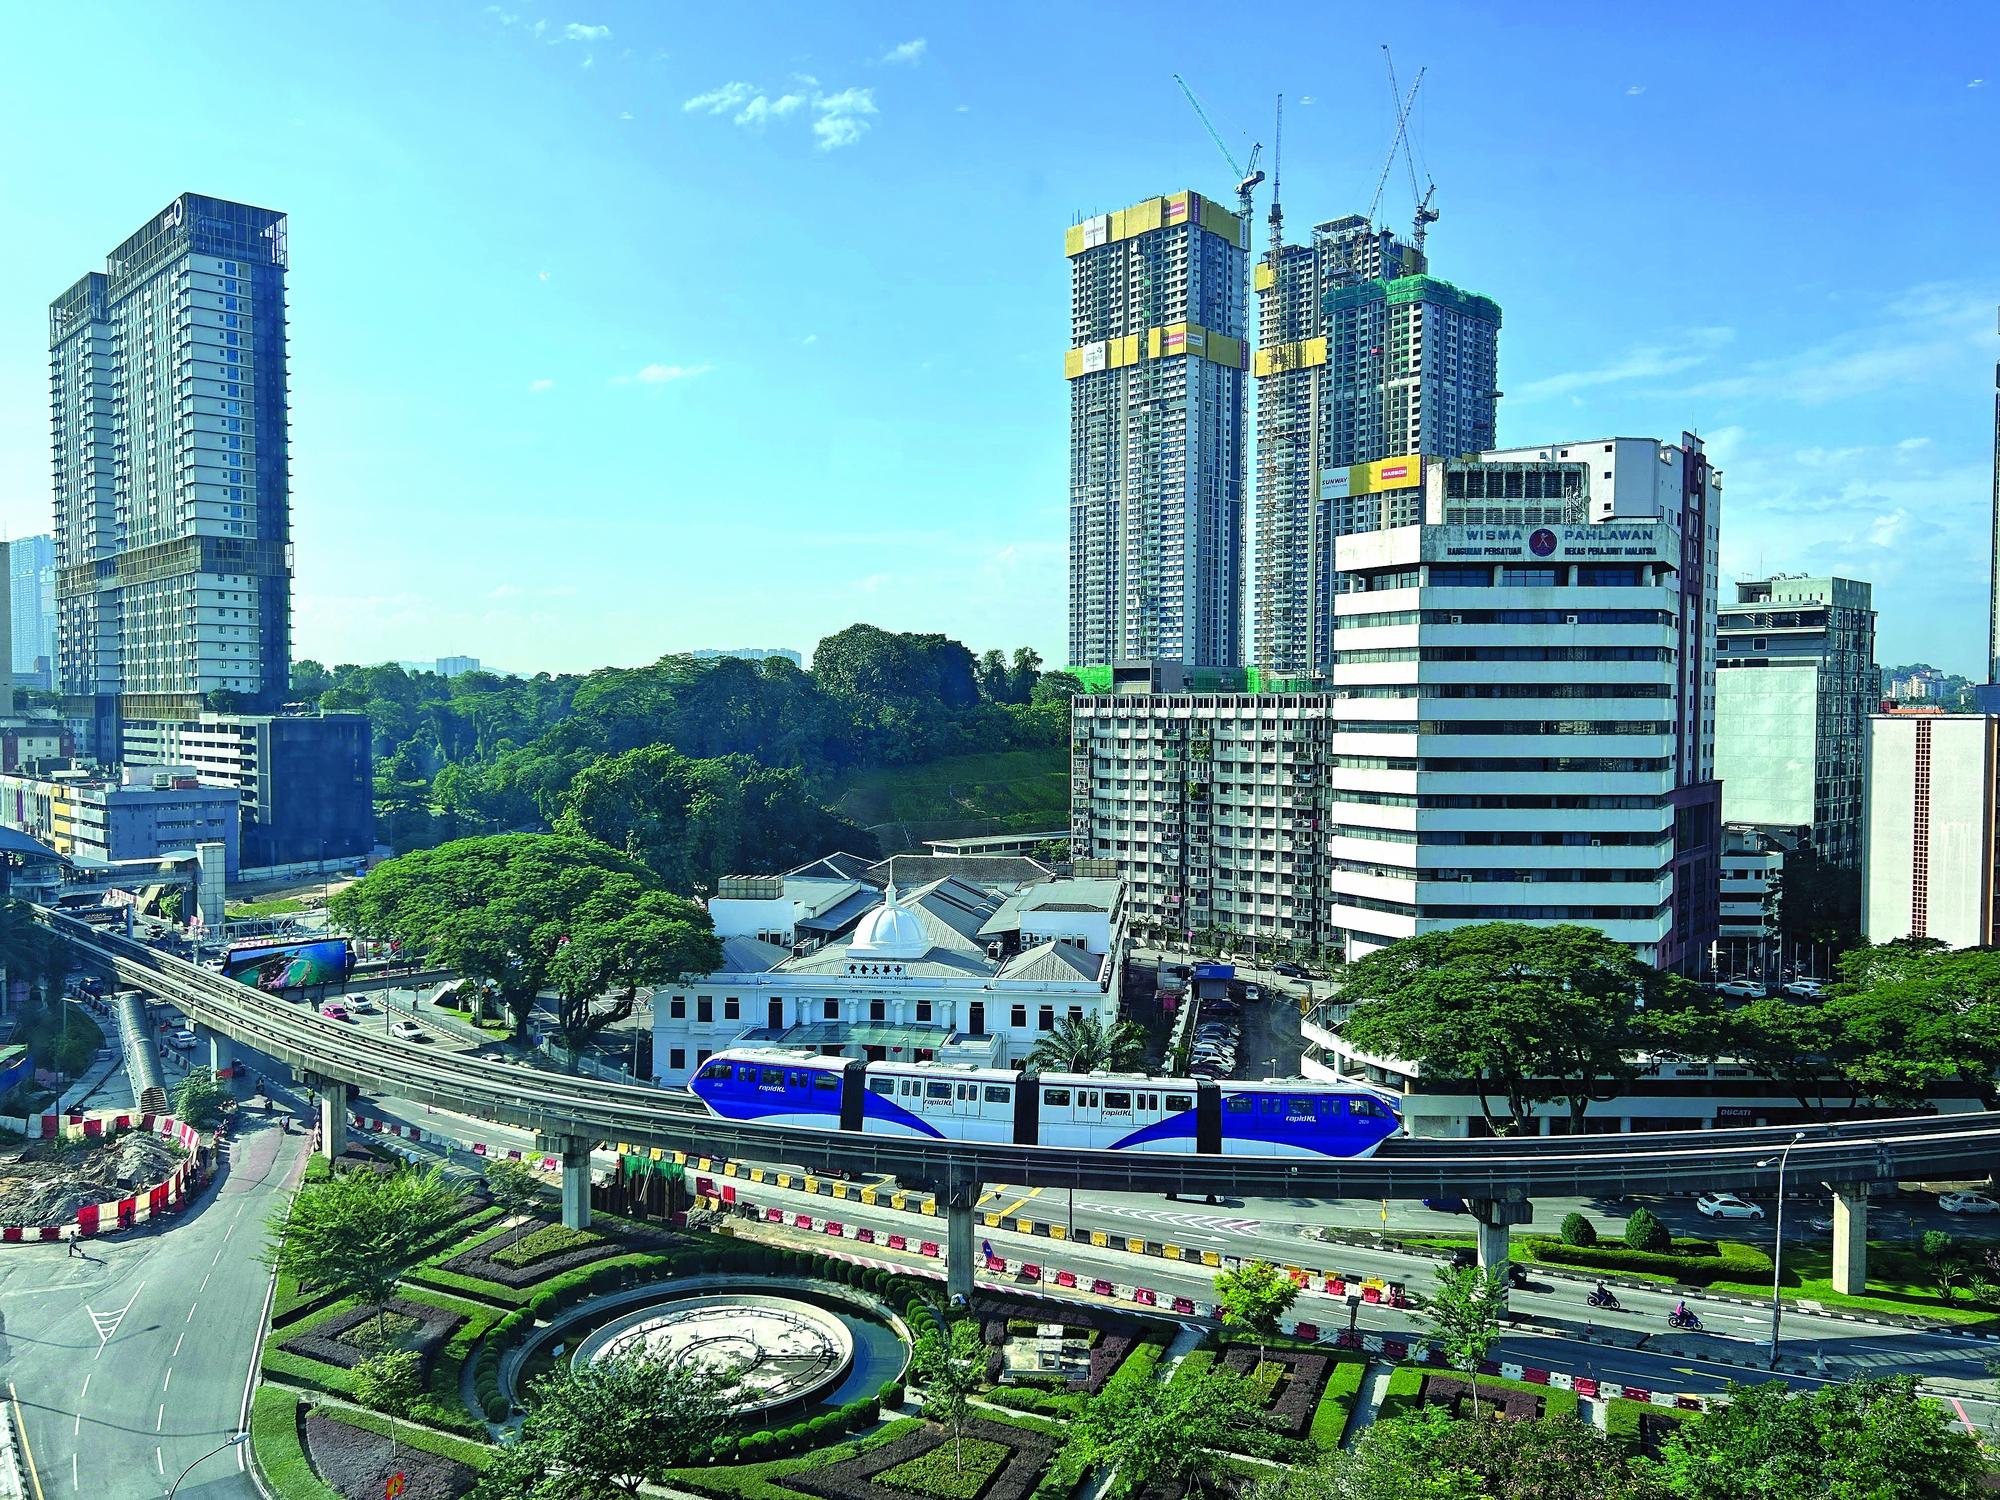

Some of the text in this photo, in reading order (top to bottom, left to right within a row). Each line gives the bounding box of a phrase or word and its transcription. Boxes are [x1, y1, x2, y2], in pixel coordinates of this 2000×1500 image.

[1322, 477, 1348, 486] SUNWAY
[1466, 530, 1653, 540] WISMA PAHLAWAN
[1447, 547, 1656, 555] BANGUNAN PERSATUAN BEKAS PERAJURIT MALAYSIA
[758, 1085, 785, 1093] rapidKL
[1285, 1115, 1317, 1123] rapidKL
